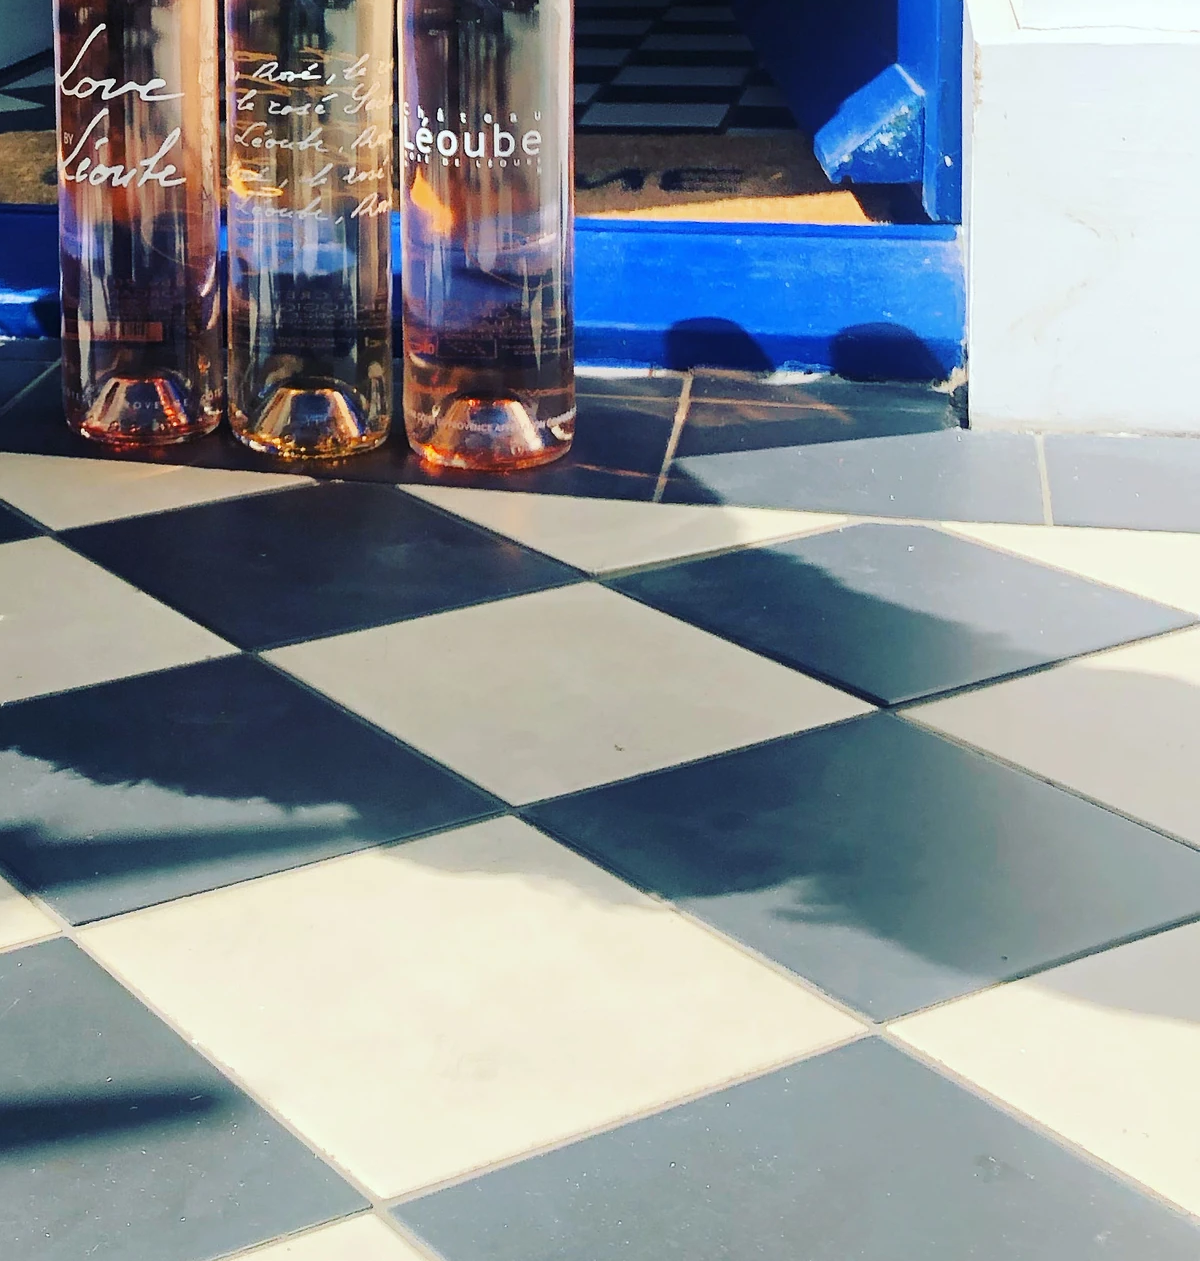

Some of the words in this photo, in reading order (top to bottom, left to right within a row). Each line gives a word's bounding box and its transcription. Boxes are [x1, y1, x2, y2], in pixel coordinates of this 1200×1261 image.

[56, 23, 185, 102] Love
[58, 107, 187, 188] Léoube
[63, 132, 74, 145] BY
[403, 115, 542, 158] Léoube
